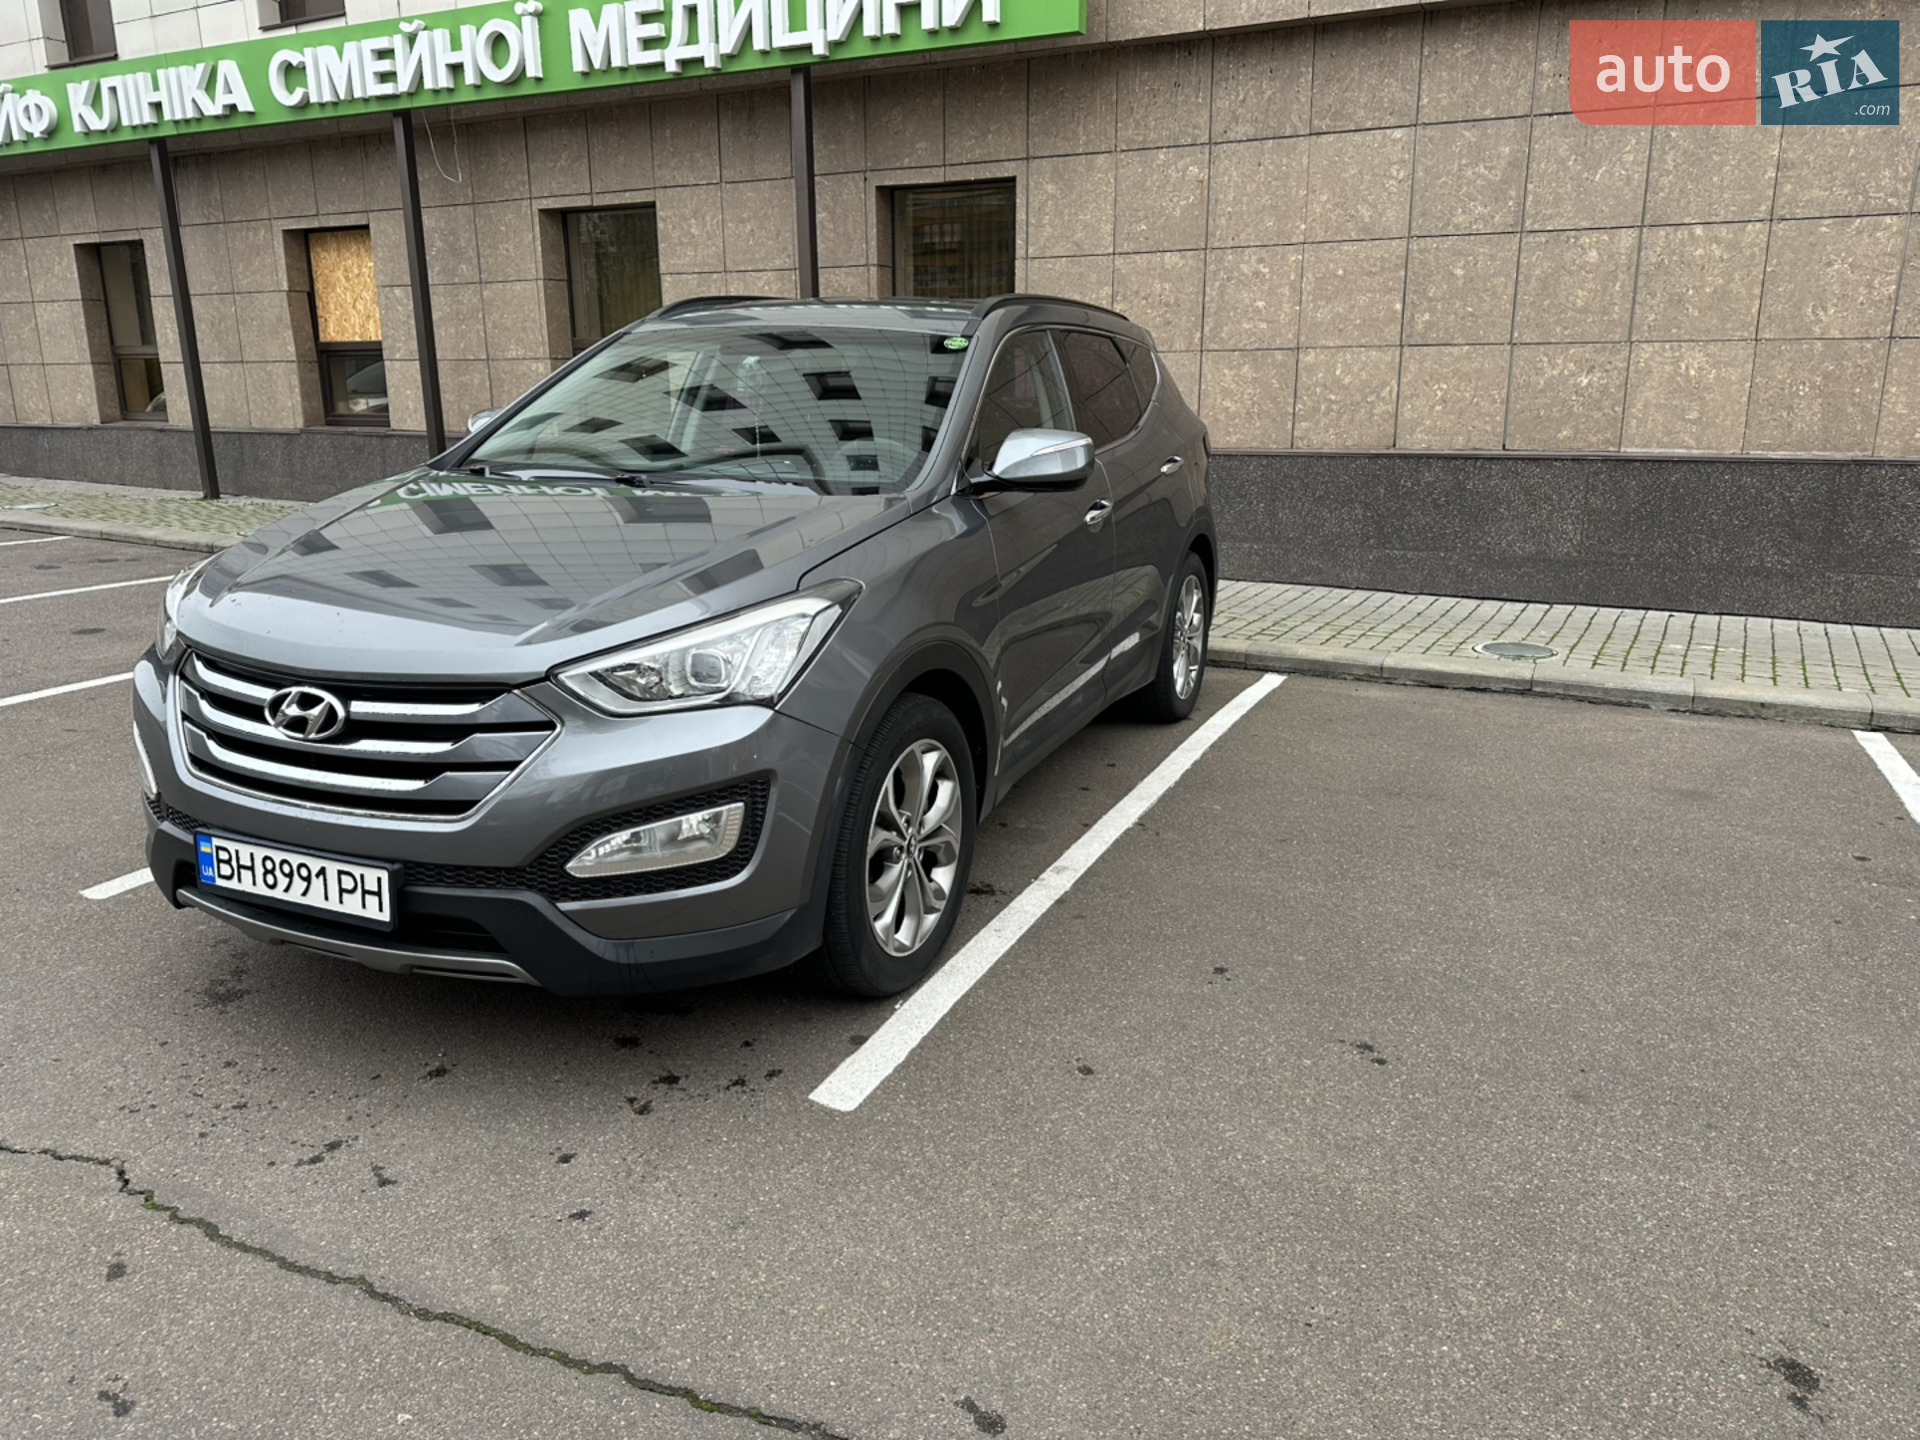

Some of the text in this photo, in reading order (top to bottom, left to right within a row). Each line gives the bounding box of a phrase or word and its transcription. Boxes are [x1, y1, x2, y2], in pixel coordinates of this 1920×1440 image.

[66, 60, 255, 134] КЛІНІКА
[268, 1, 544, 108] СІМЕЙНОЇ
[202, 865, 214, 877] UA
